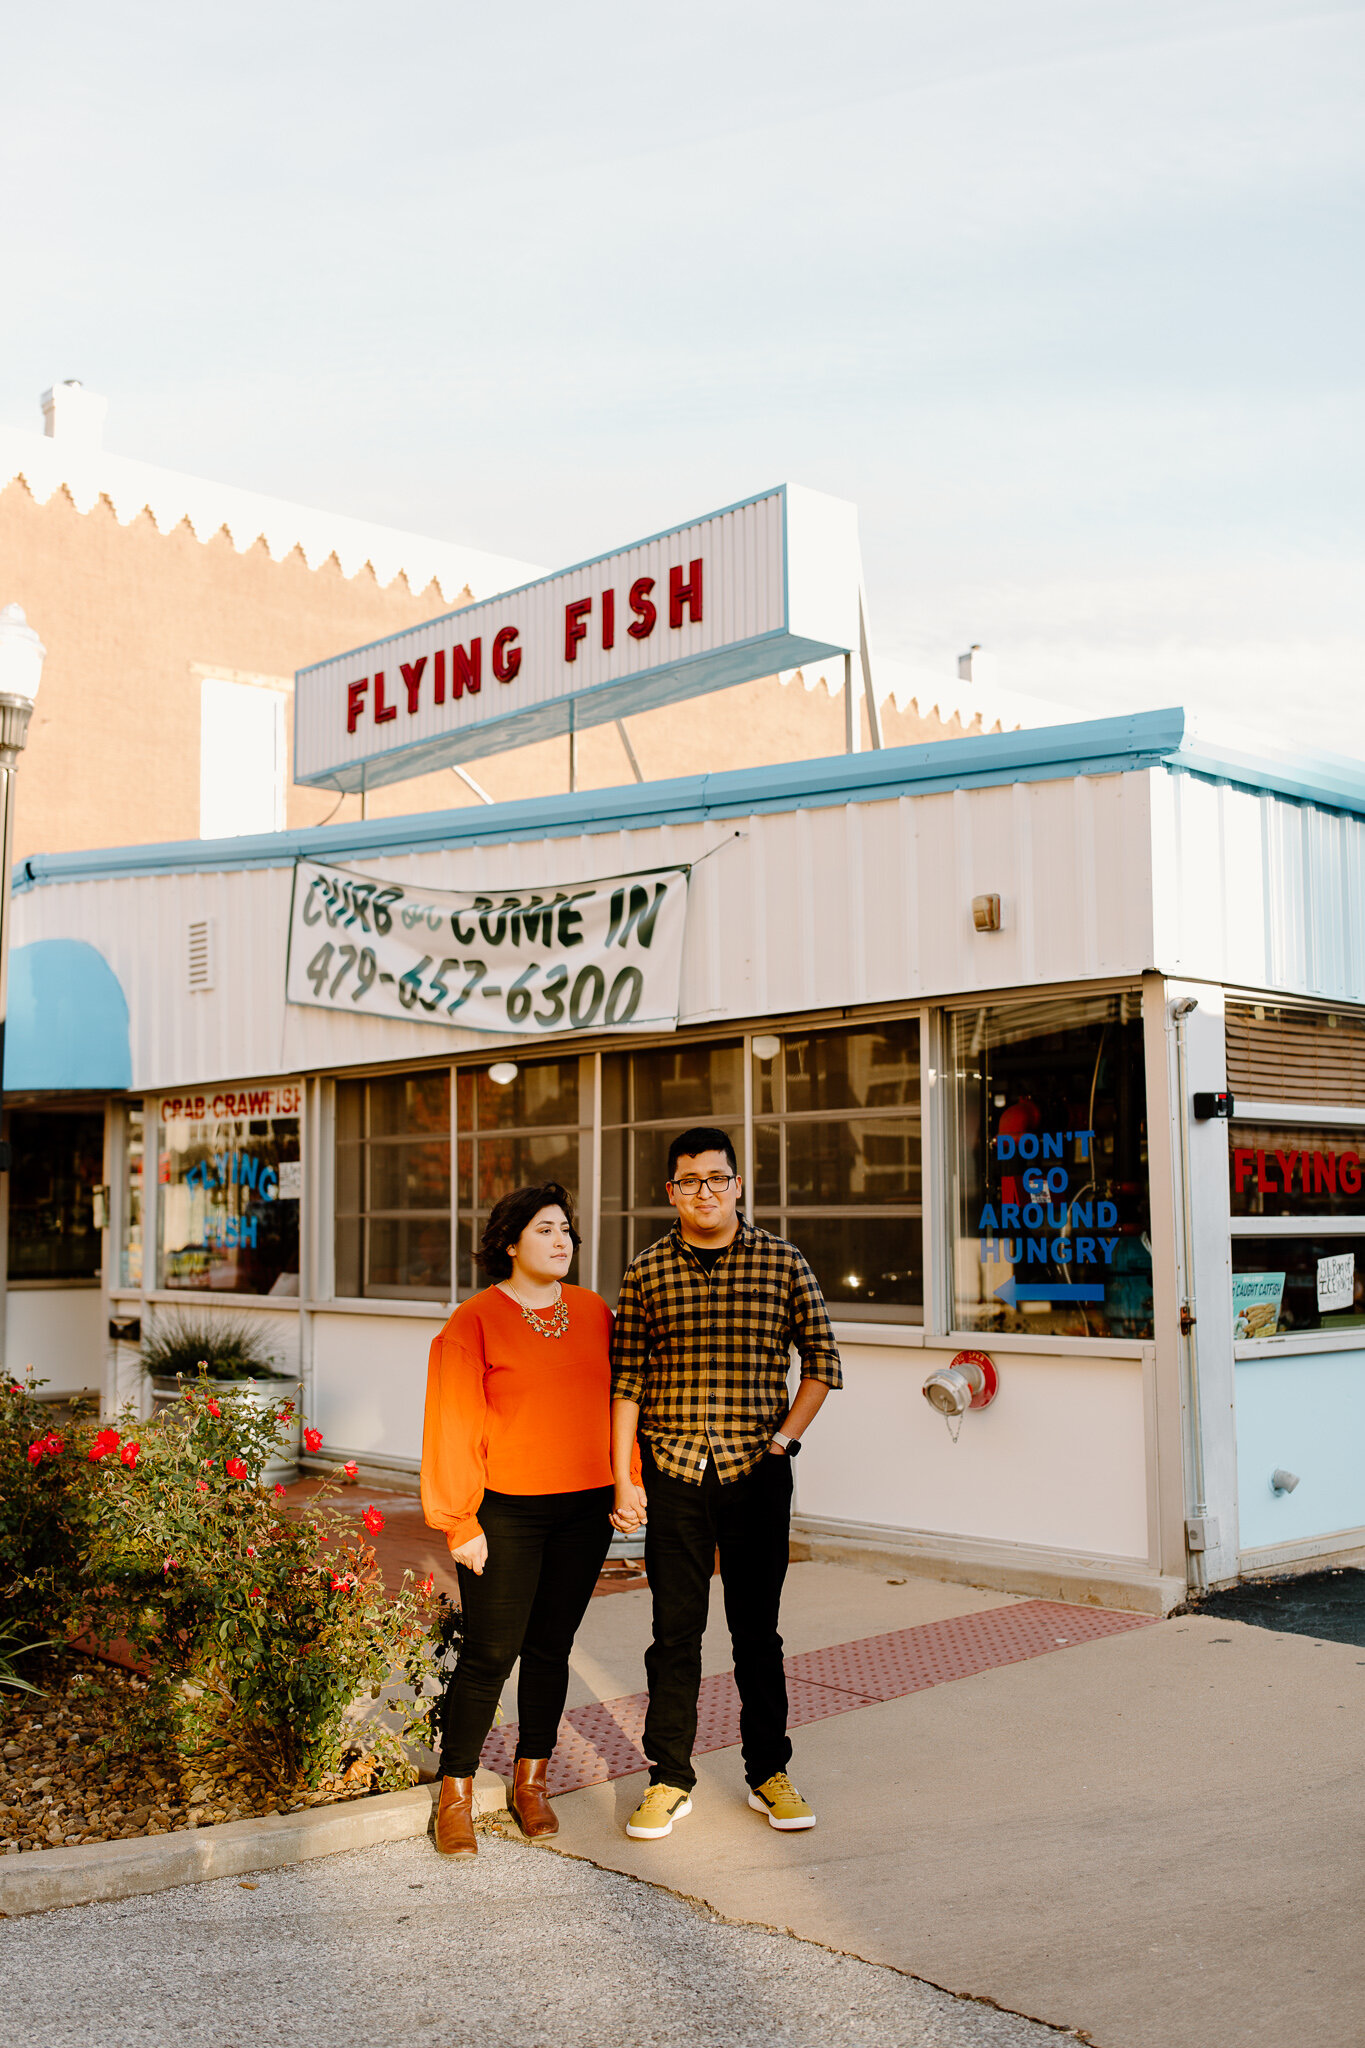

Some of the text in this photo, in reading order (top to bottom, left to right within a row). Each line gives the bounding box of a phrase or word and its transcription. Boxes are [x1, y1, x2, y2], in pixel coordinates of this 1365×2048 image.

[347, 558, 703, 734] FLYING FISH
[303, 873, 405, 937] CURB
[451, 889, 597, 947] COME
[605, 882, 669, 949] IN
[306, 941, 644, 1029] 479-657-6300
[161, 1096, 206, 1123] CRAB
[997, 1130, 1096, 1161] DON'T
[185, 1151, 278, 1202] FLYING
[1022, 1166, 1069, 1195] GO
[1233, 1148, 1363, 1195] FLYING
[978, 1201, 1119, 1230] AROUND
[203, 1215, 258, 1249] FISH
[980, 1236, 1120, 1265] HUNGRY
[1235, 1283, 1258, 1297] CAUGHT
[1258, 1282, 1282, 1296] CATFISH
[1319, 1278, 1337, 1295] ICE
